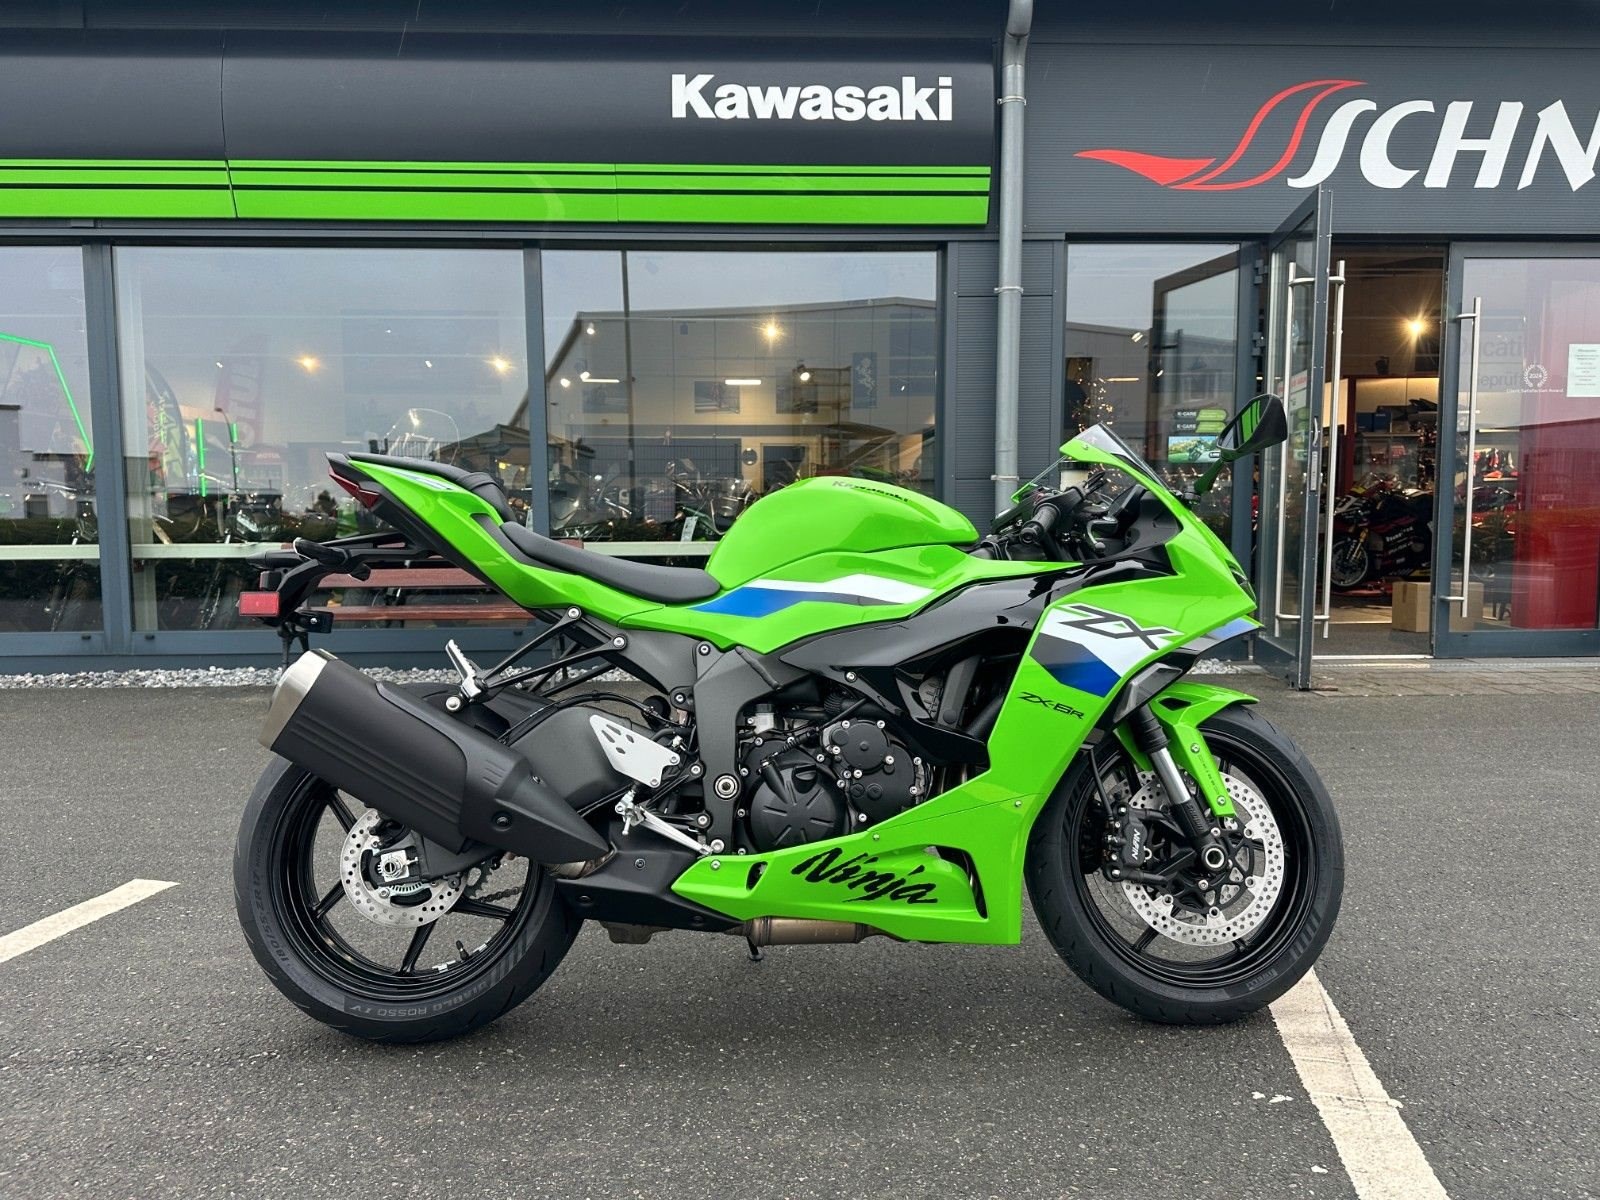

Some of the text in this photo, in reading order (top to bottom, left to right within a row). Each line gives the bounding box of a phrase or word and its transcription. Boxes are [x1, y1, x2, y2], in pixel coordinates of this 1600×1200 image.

[671, 73, 952, 121] Kawasaki
[832, 481, 909, 502] Kawasaki
[1057, 604, 1174, 651] ZX
[1018, 691, 1085, 720] ZX-6R
[791, 847, 938, 904] Ninja
[377, 1006, 428, 1017] ROSSO
